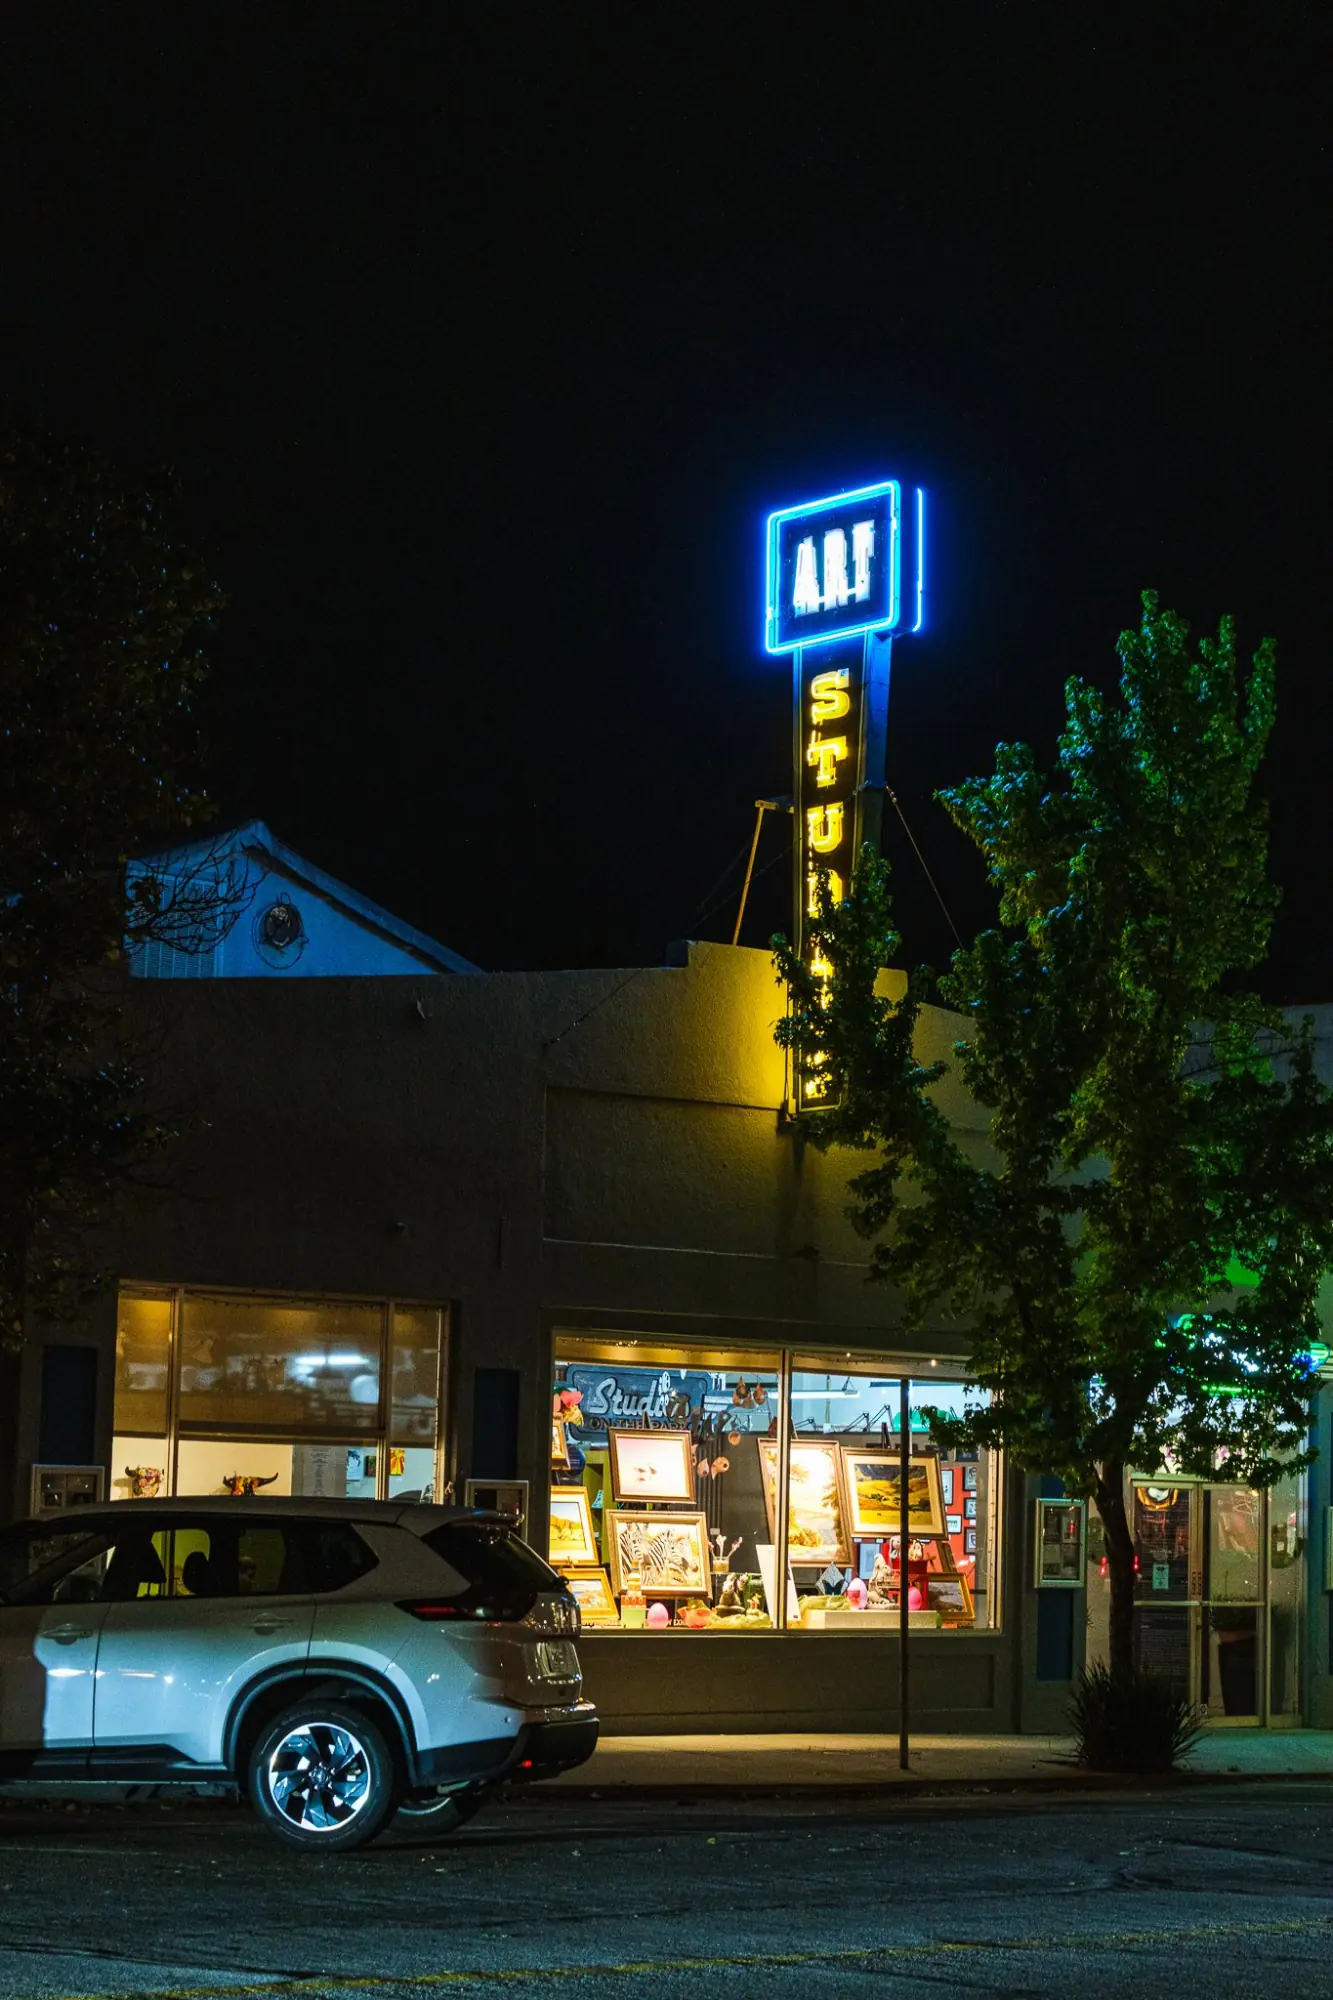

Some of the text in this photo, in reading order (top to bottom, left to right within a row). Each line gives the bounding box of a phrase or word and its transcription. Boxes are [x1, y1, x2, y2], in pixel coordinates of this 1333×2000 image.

[793, 519, 875, 619] ART
[589, 1377, 691, 1418] Studi
[590, 1417, 612, 1430] ON
